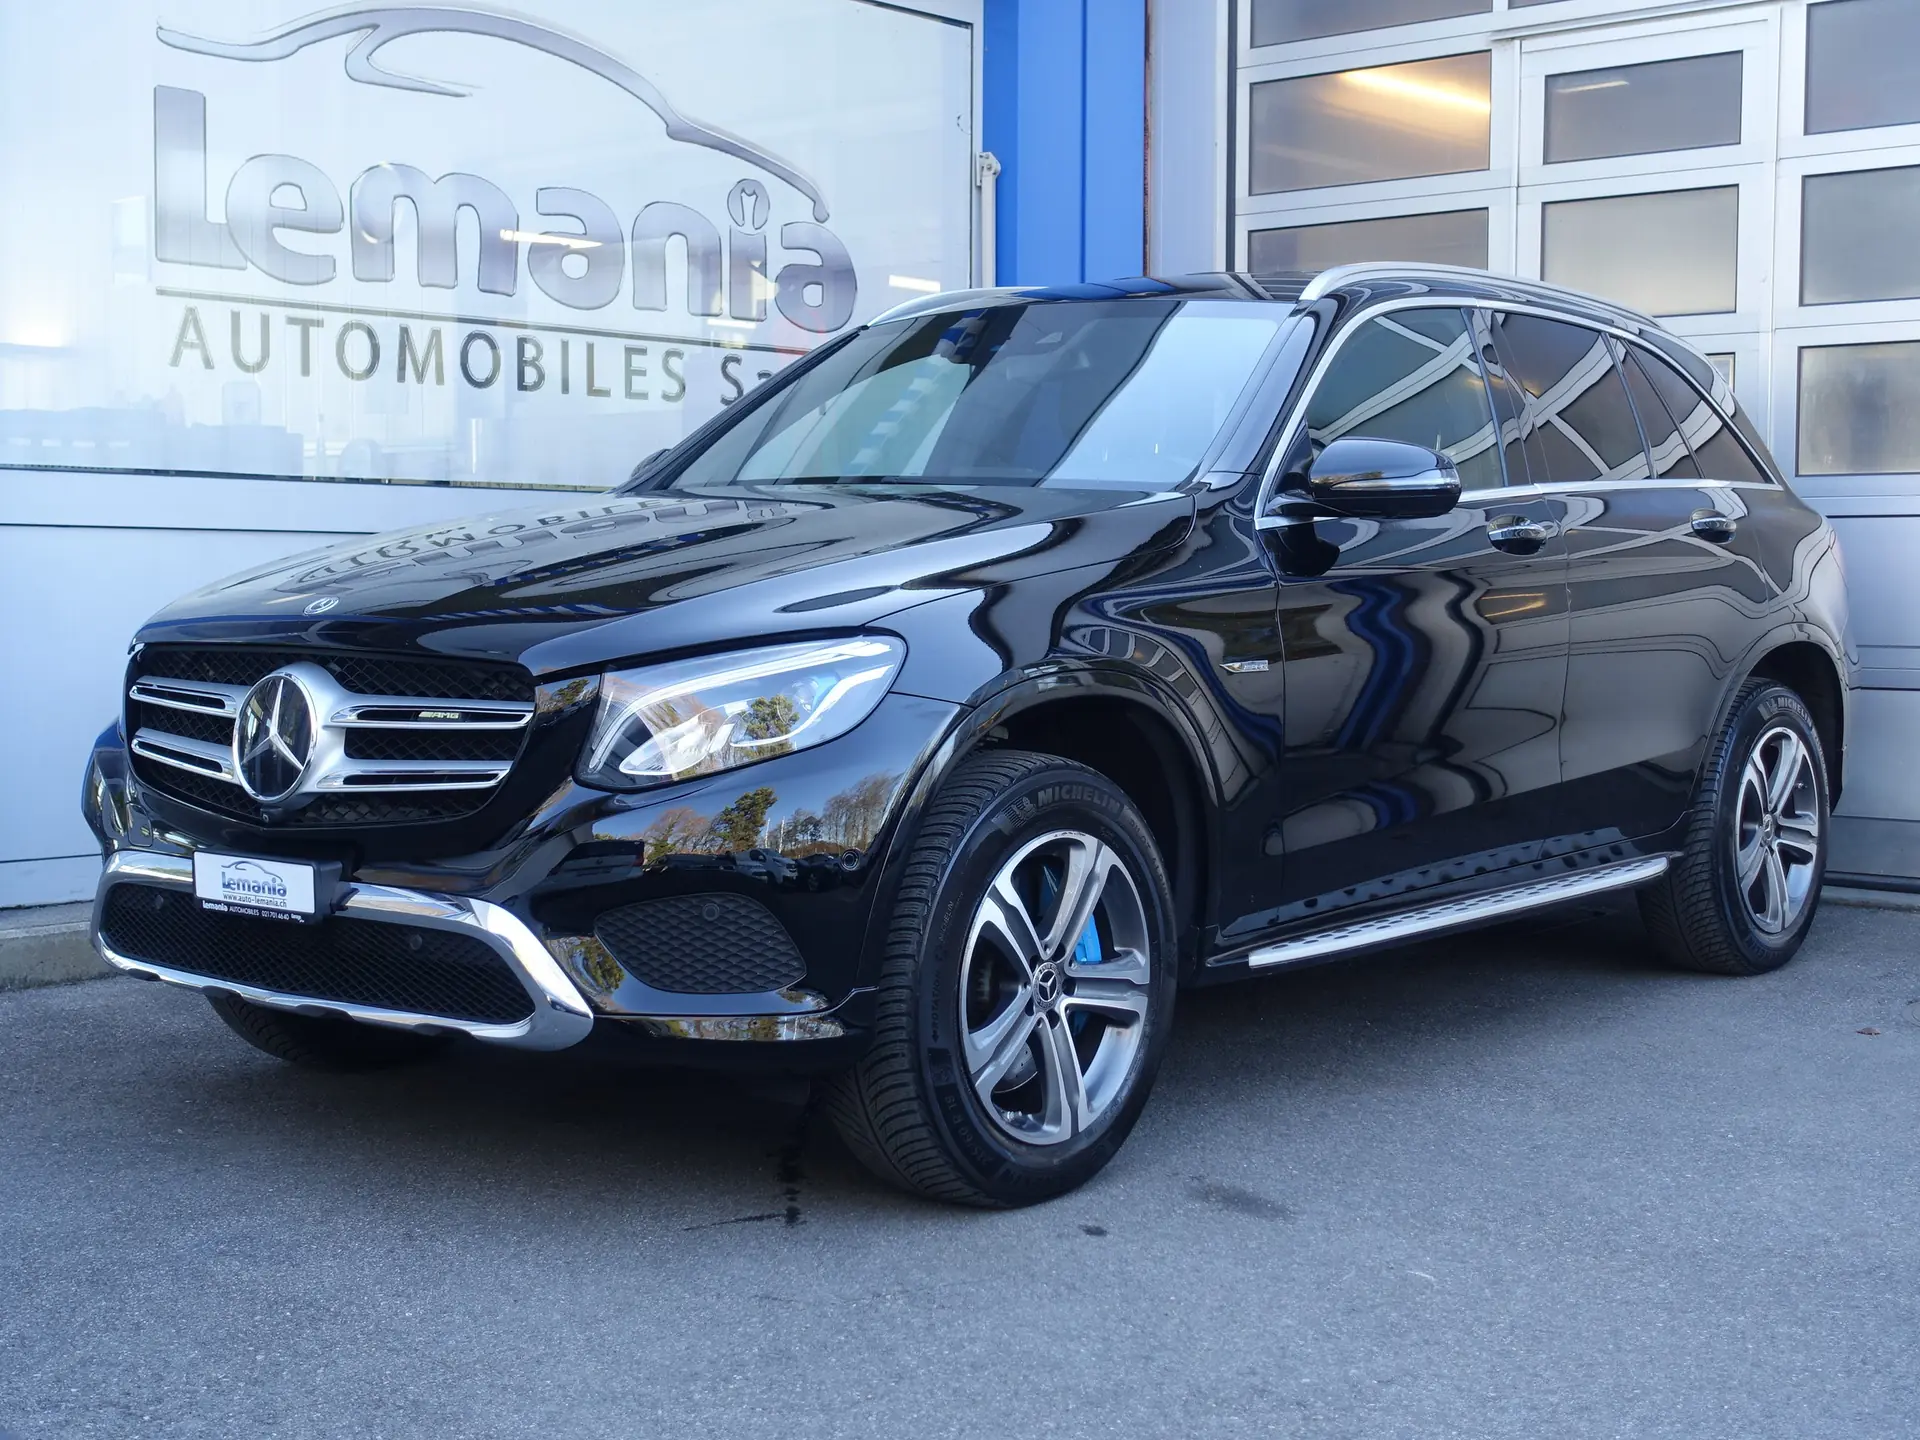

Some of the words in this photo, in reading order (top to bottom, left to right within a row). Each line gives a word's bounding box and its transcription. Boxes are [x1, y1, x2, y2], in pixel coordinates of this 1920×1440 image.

[154, 84, 857, 333] Lemania
[168, 304, 686, 403] AUTOMOBILES
[431, 711, 460, 719] AMG
[1037, 784, 1122, 815] MICHELIN
[222, 872, 287, 897] Lemania
[203, 901, 228, 911] Lemania
[230, 906, 259, 916] AUTOMOBILES
[223, 893, 287, 907] www.auto-lemania.ch
[938, 899, 955, 942] MICHELIN
